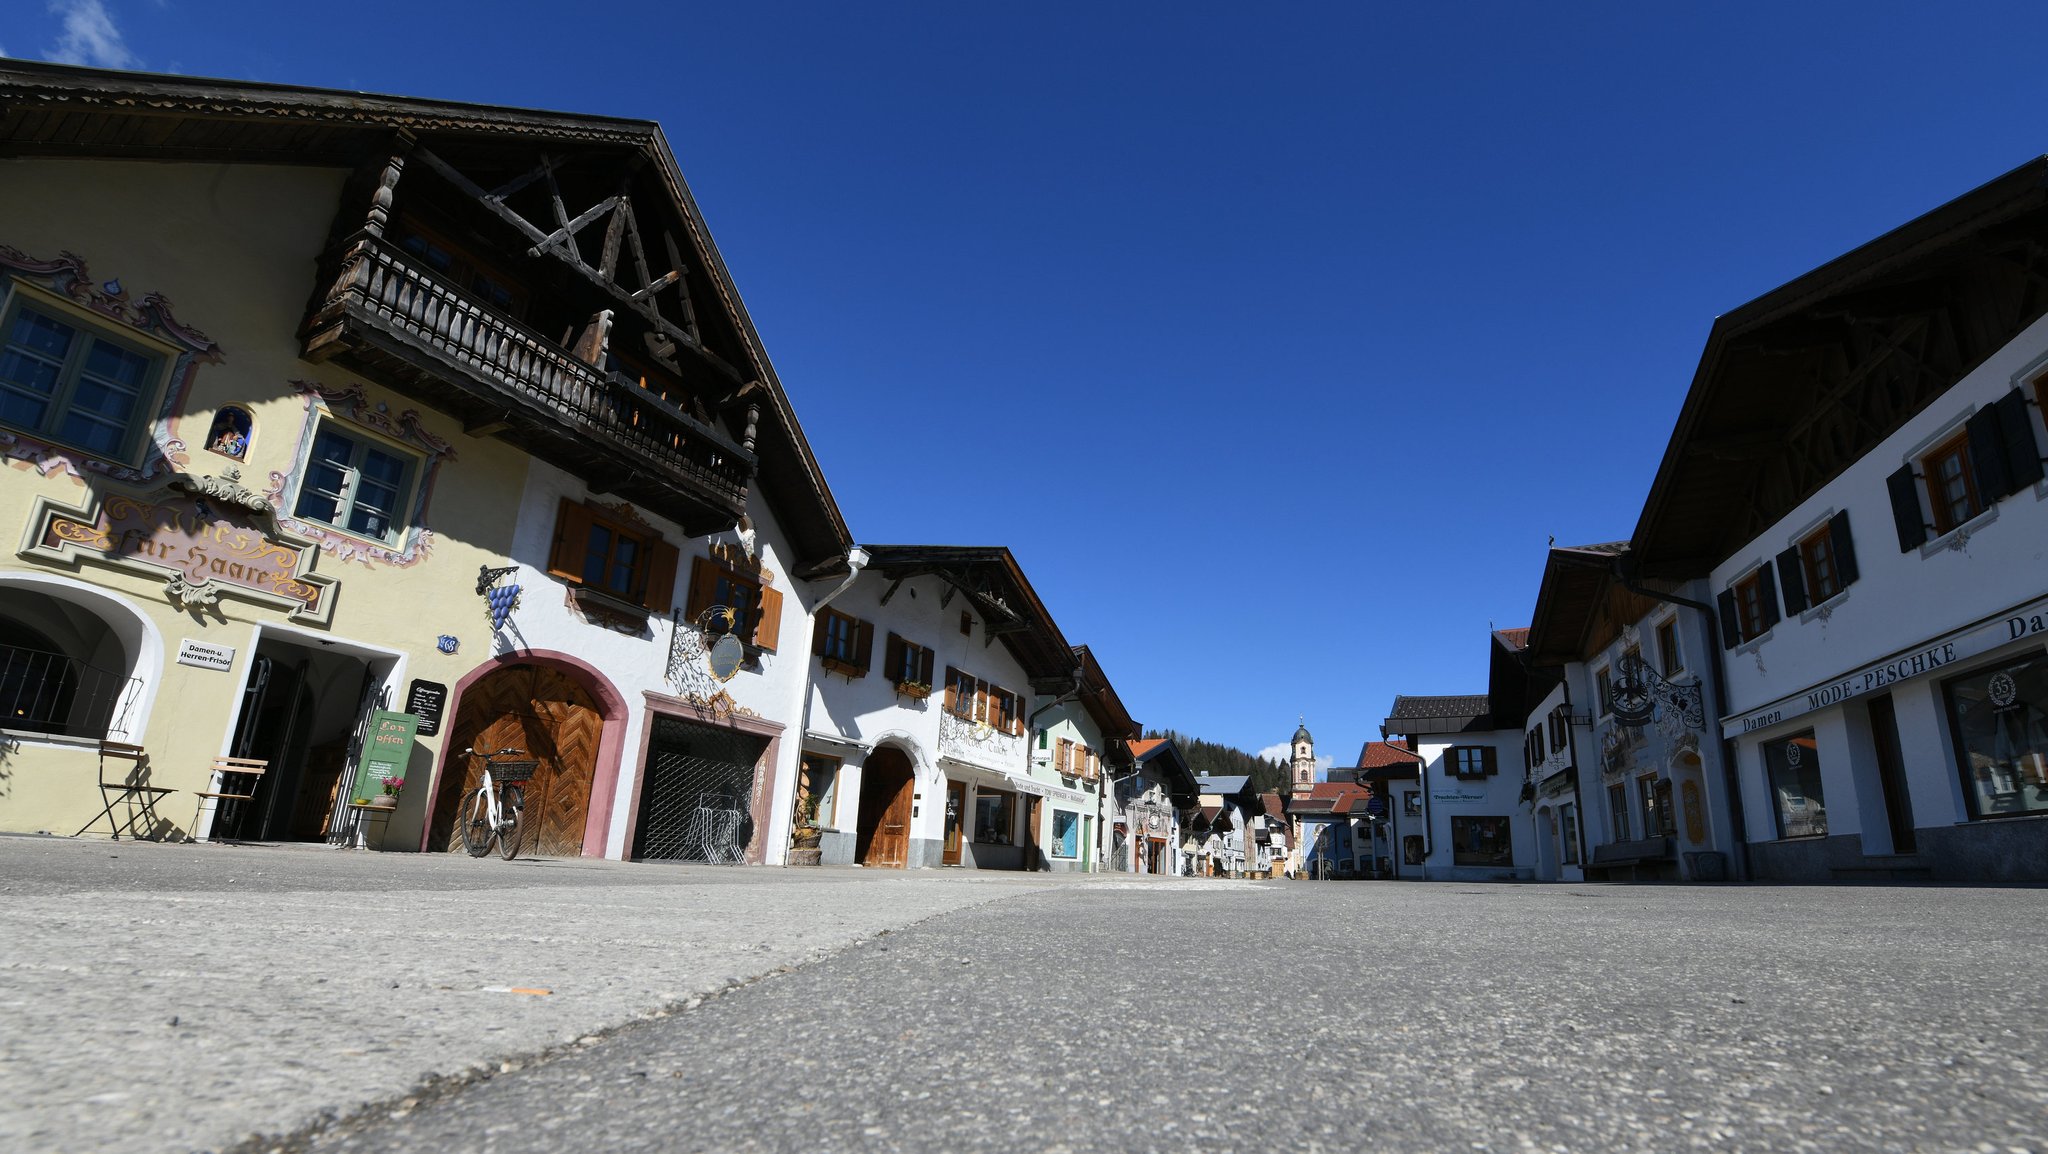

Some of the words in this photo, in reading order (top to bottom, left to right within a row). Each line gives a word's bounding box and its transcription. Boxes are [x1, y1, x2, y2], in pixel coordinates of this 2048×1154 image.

[172, 546, 271, 584] Haare
[2006, 612, 2048, 641] Da
[1994, 679, 2009, 695] 35
[1743, 711, 1782, 732] Damen
[376, 734, 404, 745] offen
